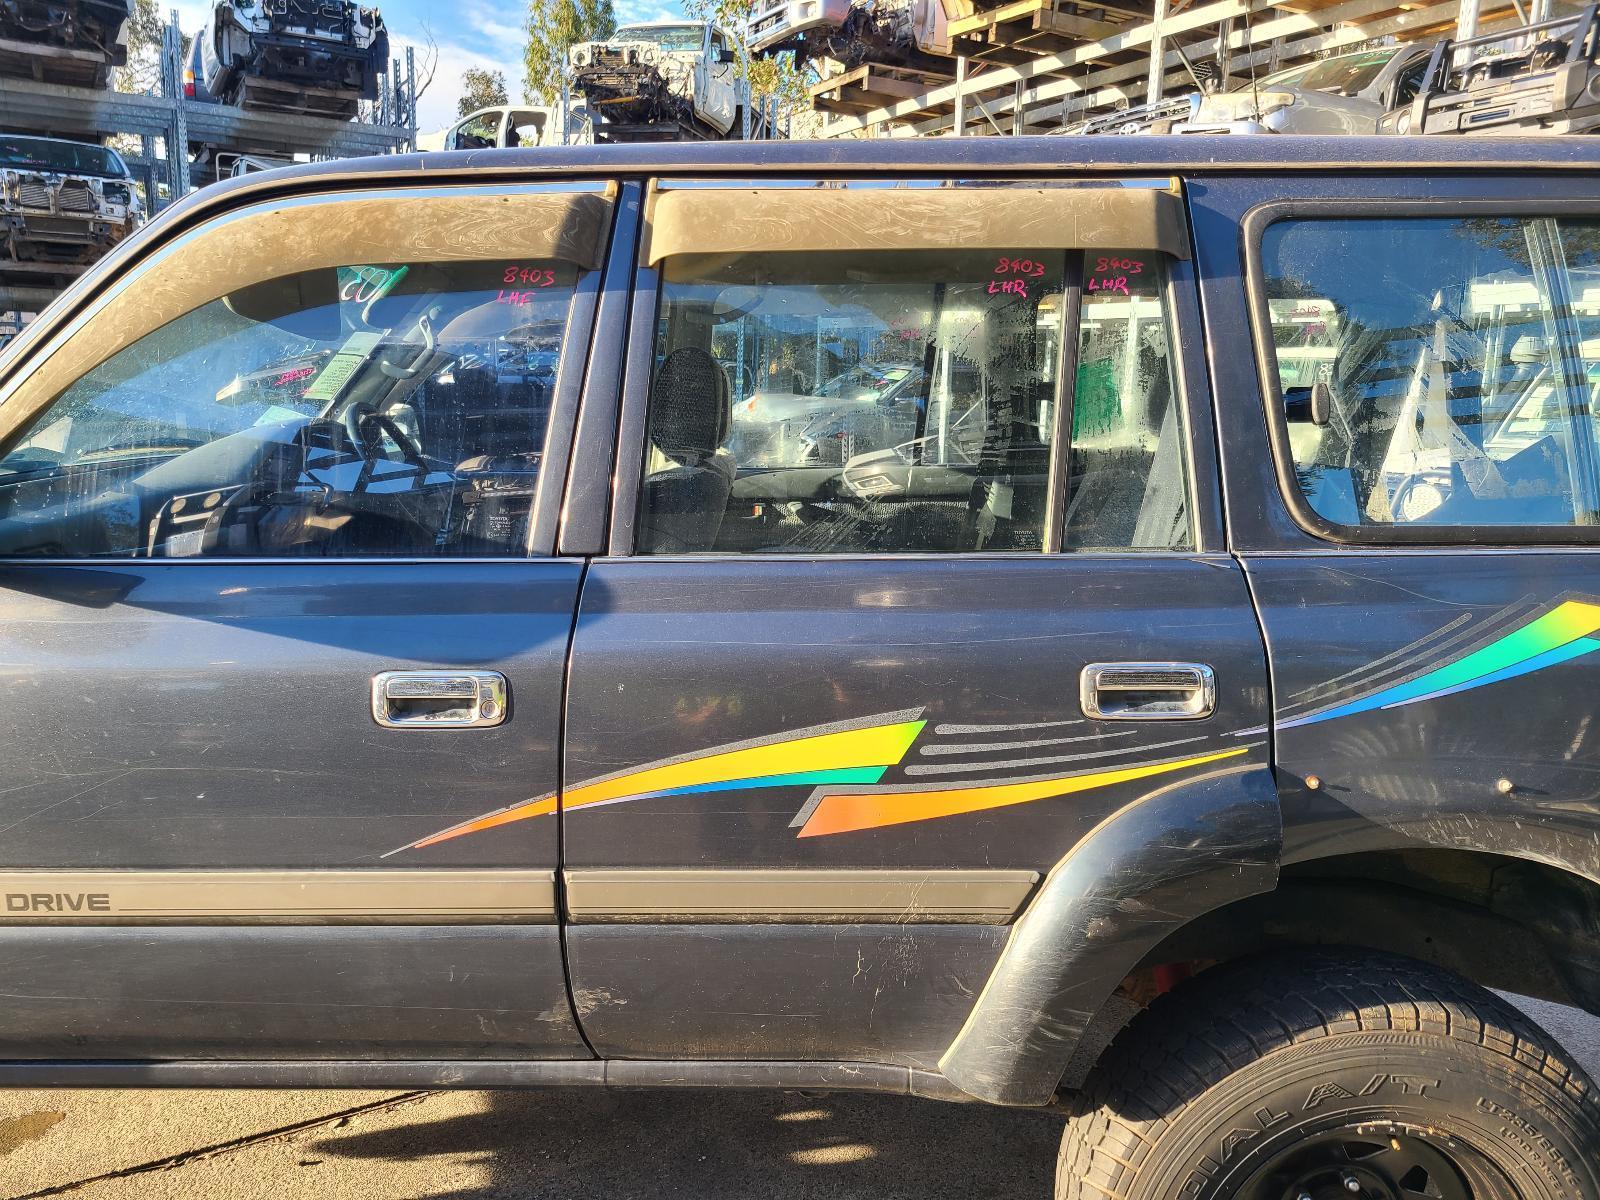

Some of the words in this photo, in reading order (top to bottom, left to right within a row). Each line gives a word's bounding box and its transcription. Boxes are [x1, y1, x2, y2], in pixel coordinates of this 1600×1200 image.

[994, 257, 1045, 277] 8403
[1095, 257, 1144, 274] 8403
[503, 265, 555, 287] 8403
[1088, 276, 1129, 296] LHR
[987, 279, 1027, 298] LHR
[5, 893, 111, 912] DRIVE
[1301, 1073, 1442, 1111] A/T
